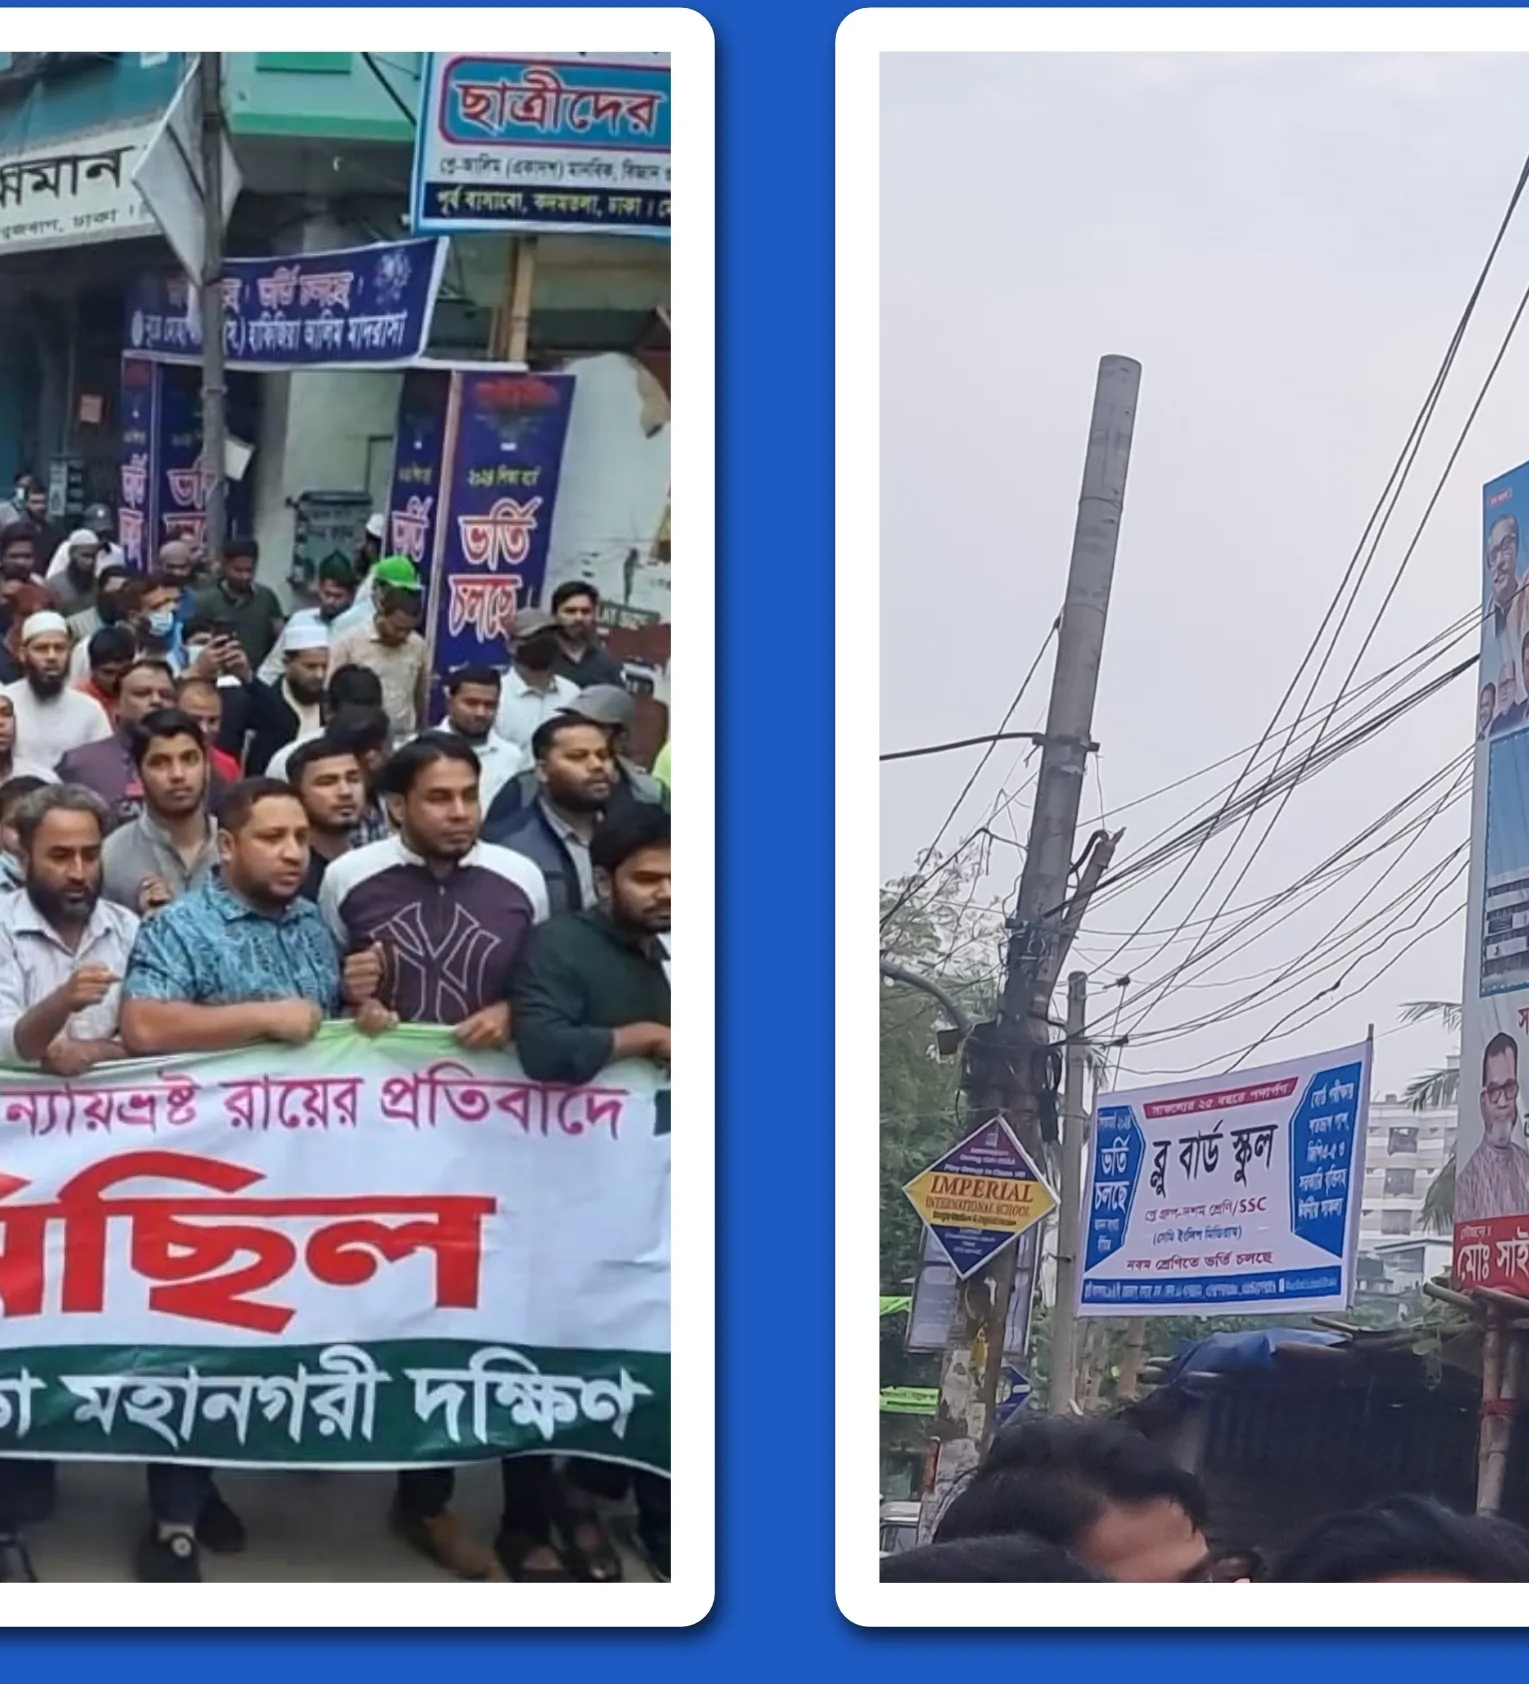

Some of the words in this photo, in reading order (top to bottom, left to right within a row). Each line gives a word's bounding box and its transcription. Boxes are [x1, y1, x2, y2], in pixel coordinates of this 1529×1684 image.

[454, 65, 666, 136] ছাত্রীদের
[221, 1073, 365, 1132] রায়ের
[379, 1060, 629, 1141] প্রতিবাদে
[1179, 1119, 1224, 1180] বার্ড
[1230, 1123, 1279, 1188] স্কুল
[925, 1196, 994, 1214] INTERNATIONAL
[995, 1201, 1032, 1217] SCHOOL
[930, 1175, 1034, 1203] IMPERIAL
[59, 1344, 394, 1452] মহানগরী
[405, 1345, 654, 1446] দক্ষিণ
